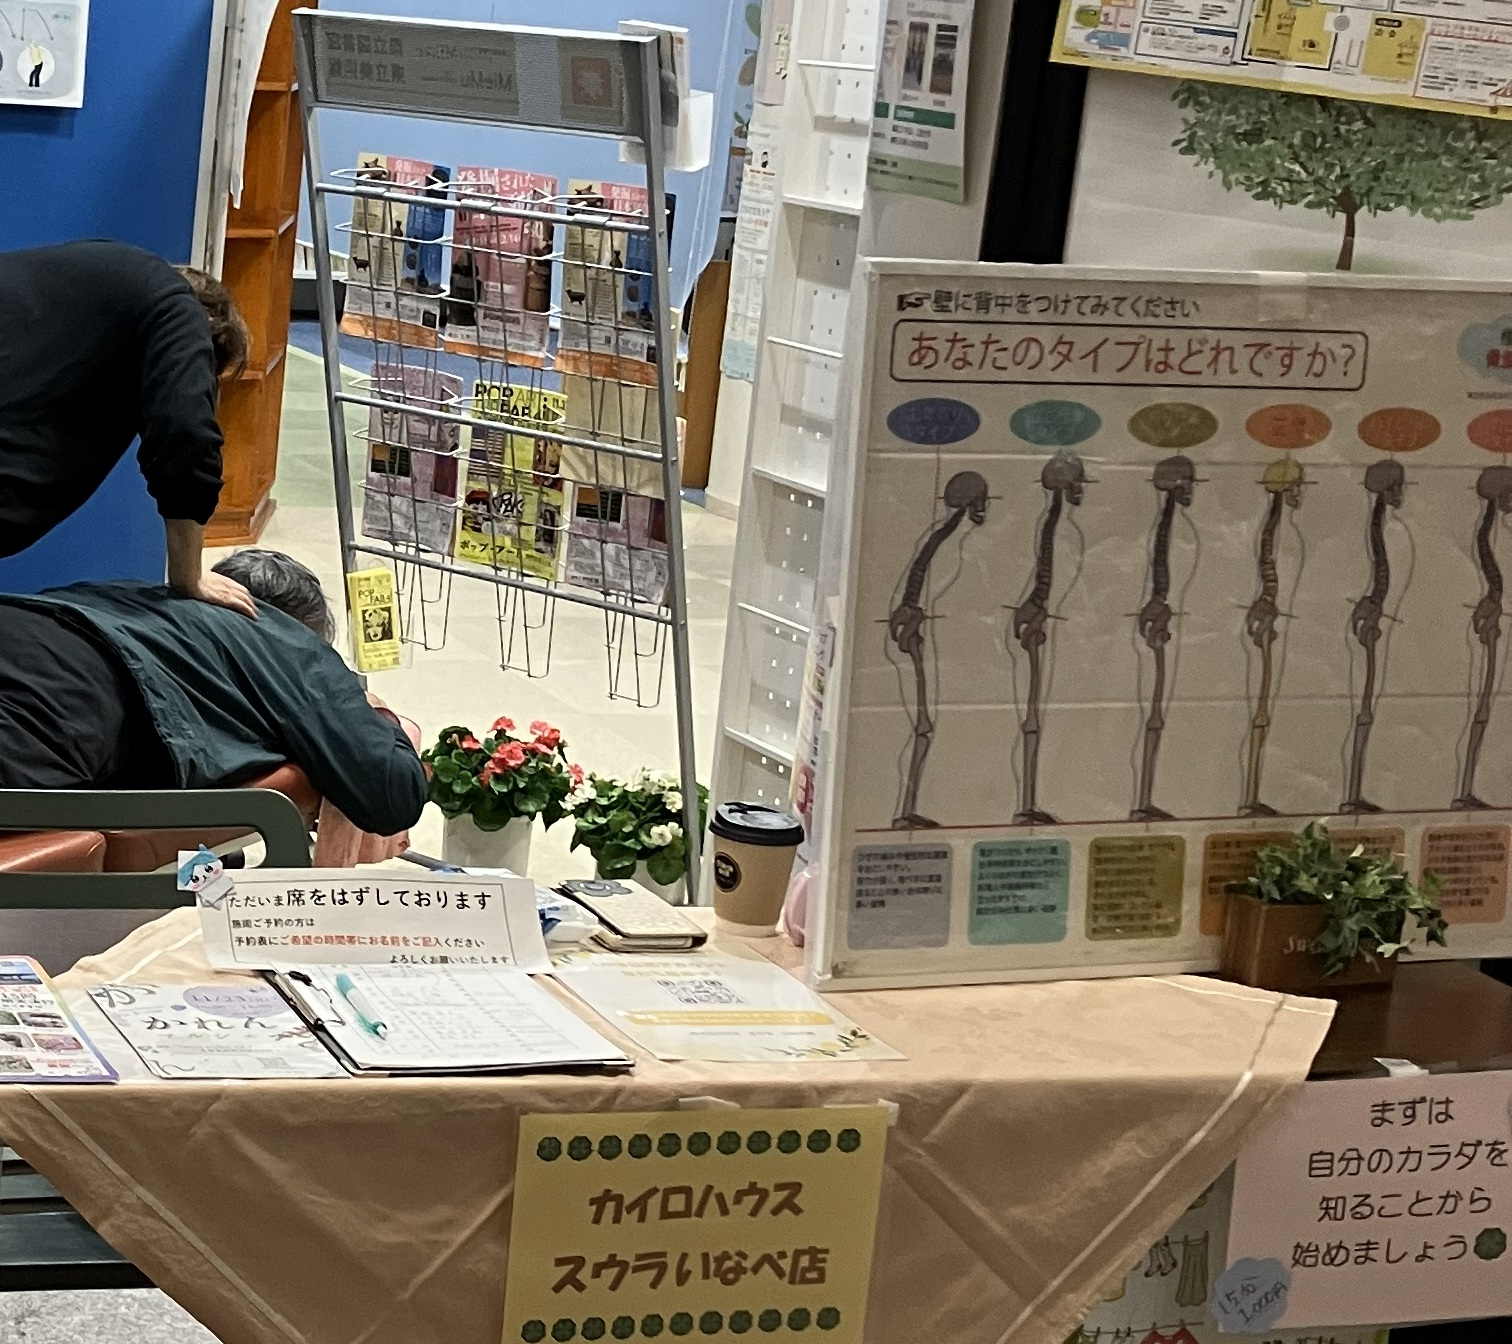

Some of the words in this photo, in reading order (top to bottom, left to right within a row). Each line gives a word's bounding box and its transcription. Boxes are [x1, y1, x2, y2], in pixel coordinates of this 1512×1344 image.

[931, 289, 1201, 318] 壁に背中をつけてみてください
[907, 331, 1356, 378] あなたのタイプはどれですか?
[228, 886, 492, 911] ただいま席をはずしております
[389, 954, 509, 966] よろしくお願いいたします
[1370, 1096, 1455, 1127] まずは
[1308, 1139, 1509, 1178] 自分のカラダを
[588, 1181, 804, 1225] カイロハウス
[1317, 1187, 1492, 1222] 知ることから
[1291, 1234, 1468, 1268] 始めましょう
[551, 1246, 830, 1294] スウラいなべ店
